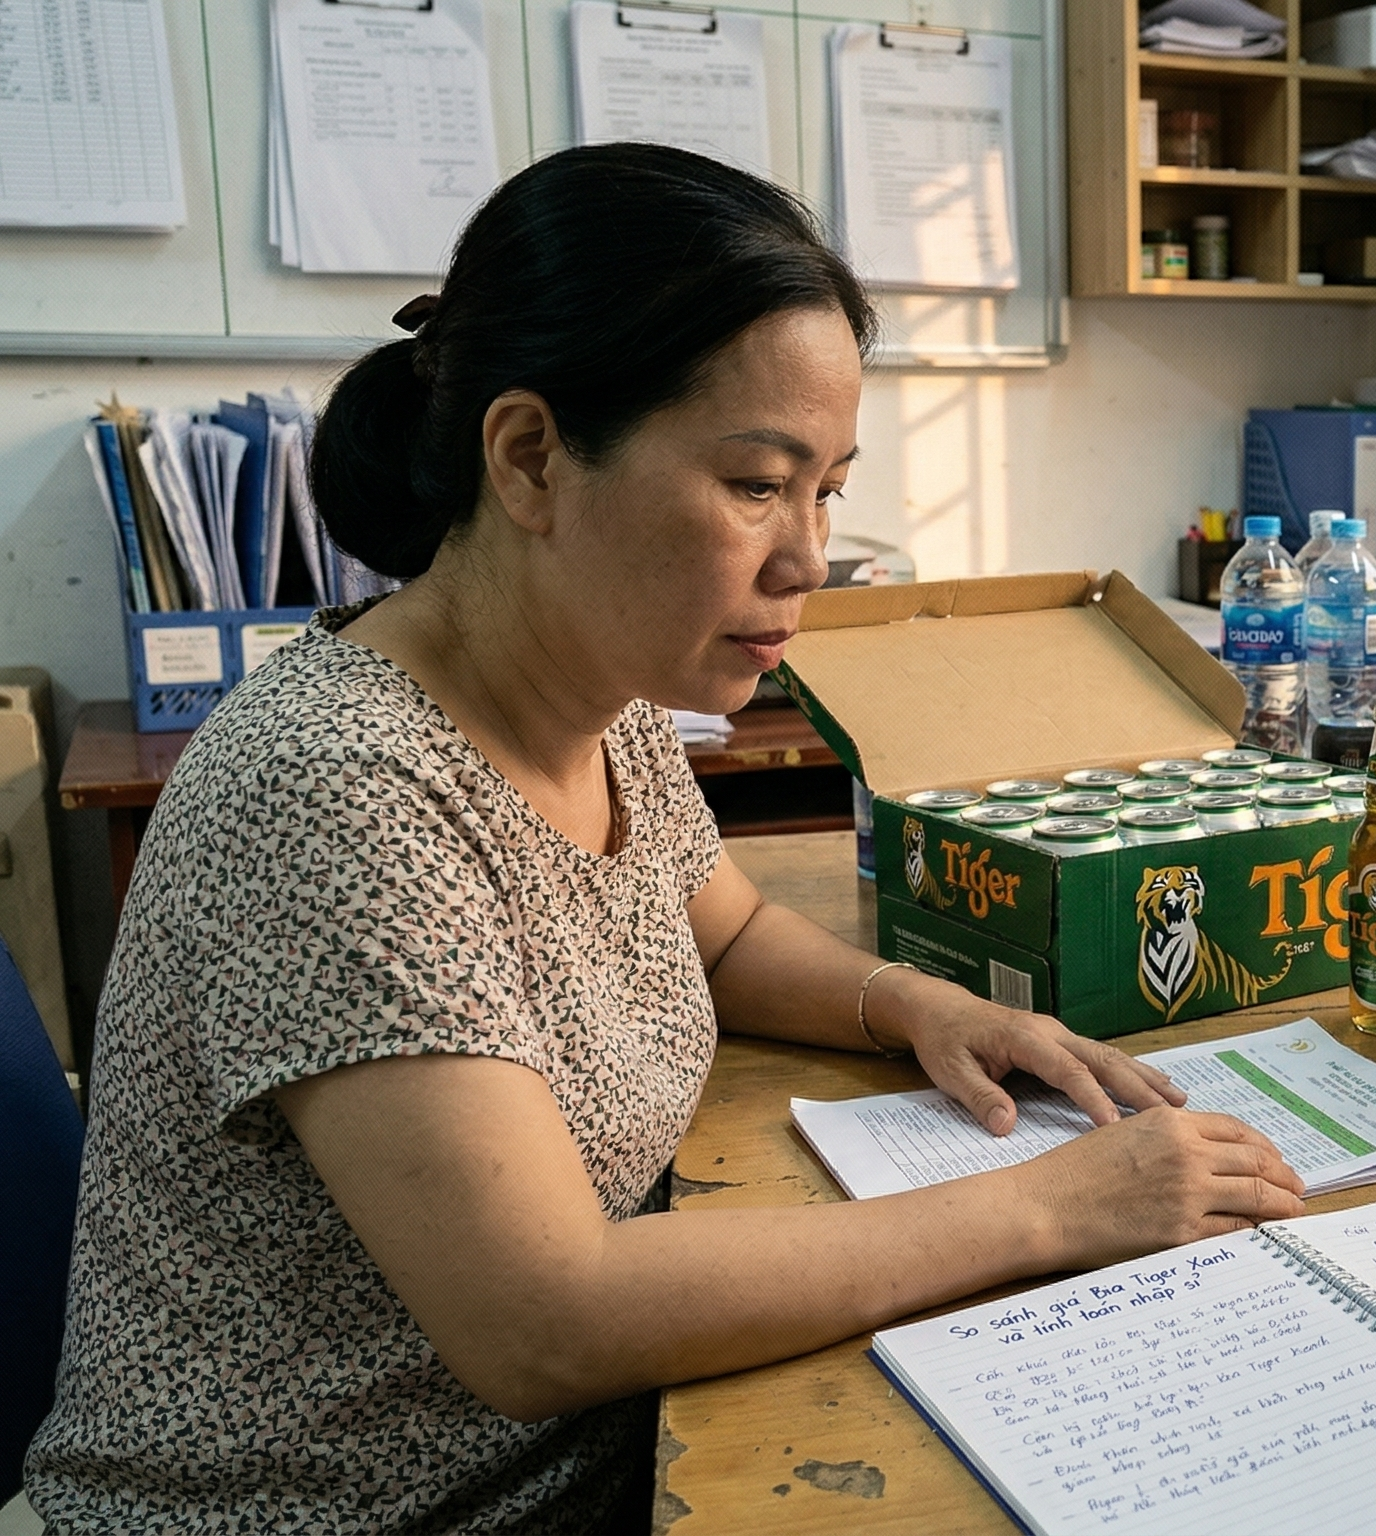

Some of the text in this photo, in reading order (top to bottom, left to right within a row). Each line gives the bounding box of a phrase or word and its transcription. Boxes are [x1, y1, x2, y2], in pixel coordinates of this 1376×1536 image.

[940, 839, 1021, 919] Tiger
[1249, 845, 1350, 962] Tig
[949, 1248, 1236, 1340] So sánh giá Bia Tiger Xanh
[1033, 1316, 1073, 1337] tính
[1079, 1301, 1122, 1322] toán
